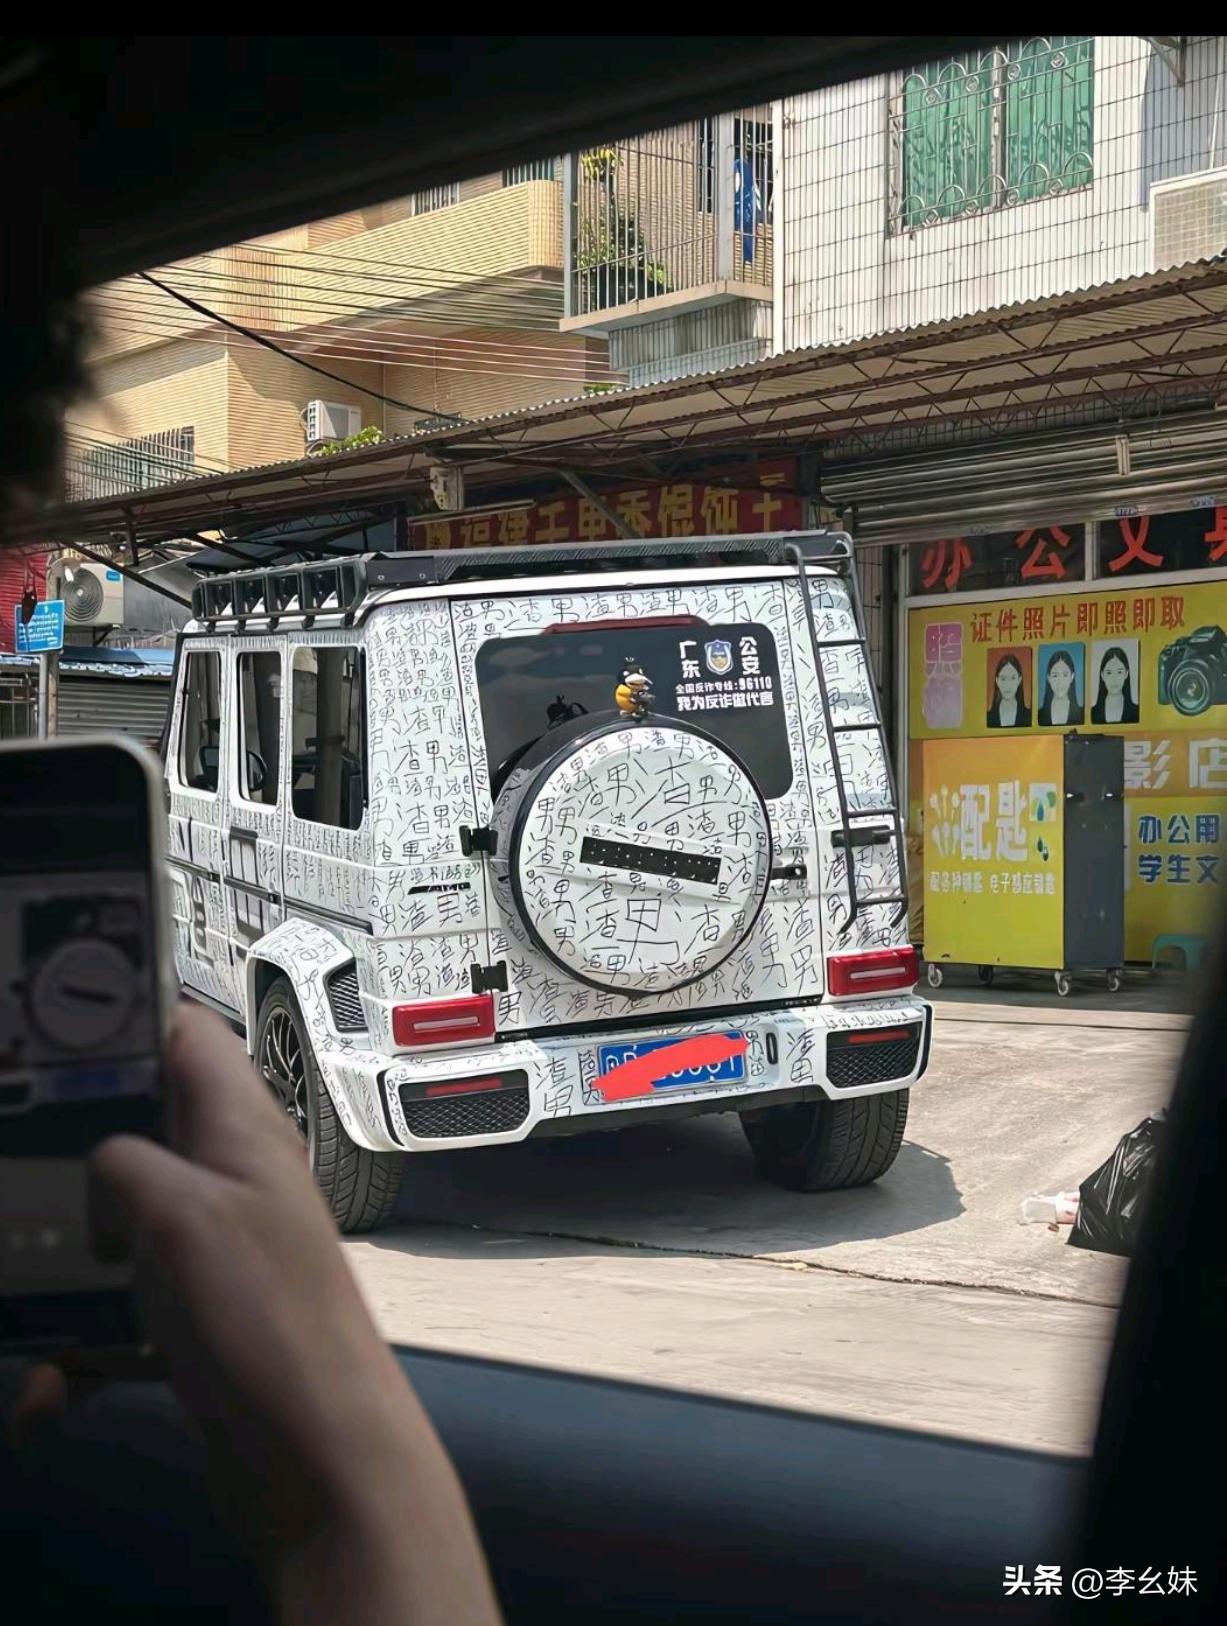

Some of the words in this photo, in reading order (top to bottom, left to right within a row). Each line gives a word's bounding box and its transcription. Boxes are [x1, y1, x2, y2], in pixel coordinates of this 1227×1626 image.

[970, 596, 1186, 643] 证件照片即照即取
[679, 640, 701, 679] 广东
[739, 636, 760, 675] 公安
[1138, 815, 1220, 844] 办公用
[1138, 854, 1220, 884] 学生文
